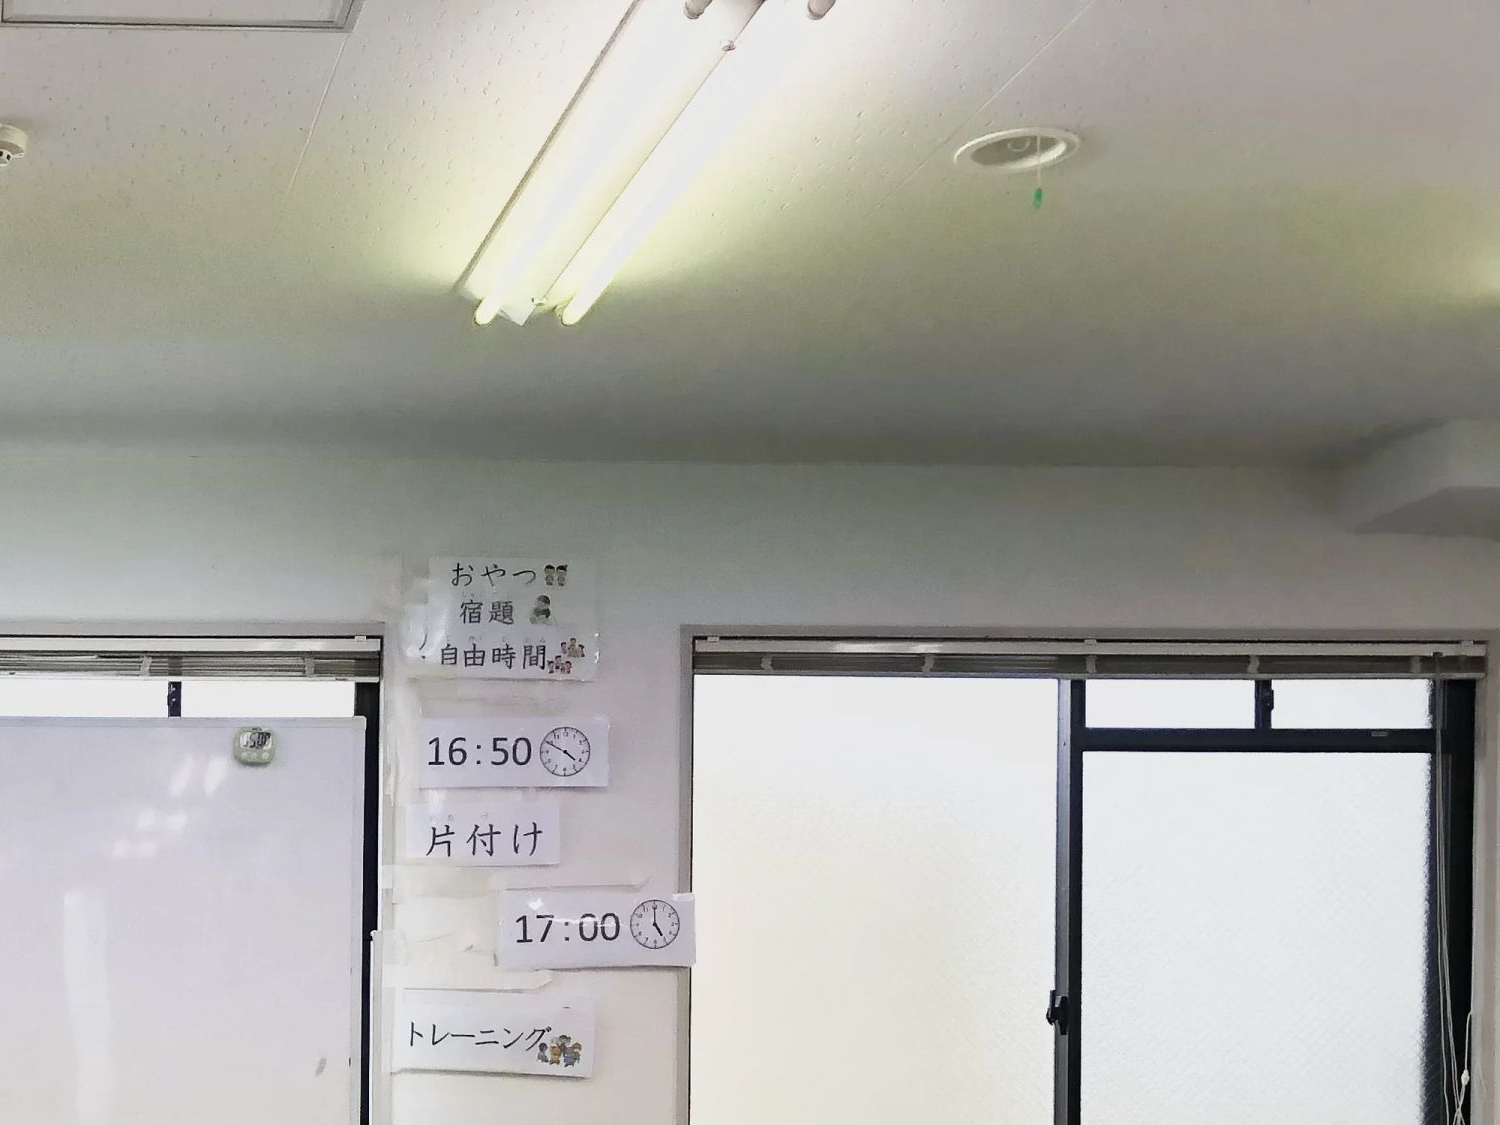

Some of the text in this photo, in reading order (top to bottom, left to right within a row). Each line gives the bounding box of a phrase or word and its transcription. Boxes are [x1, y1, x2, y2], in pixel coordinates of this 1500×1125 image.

[451, 563, 536, 587] おやつ
[459, 599, 515, 625] 宿題
[440, 643, 546, 670] 自由時間
[427, 736, 532, 766] 16:50
[426, 821, 543, 858] 片付け
[515, 912, 621, 944] 17:00
[409, 1021, 552, 1052] トレーニング
